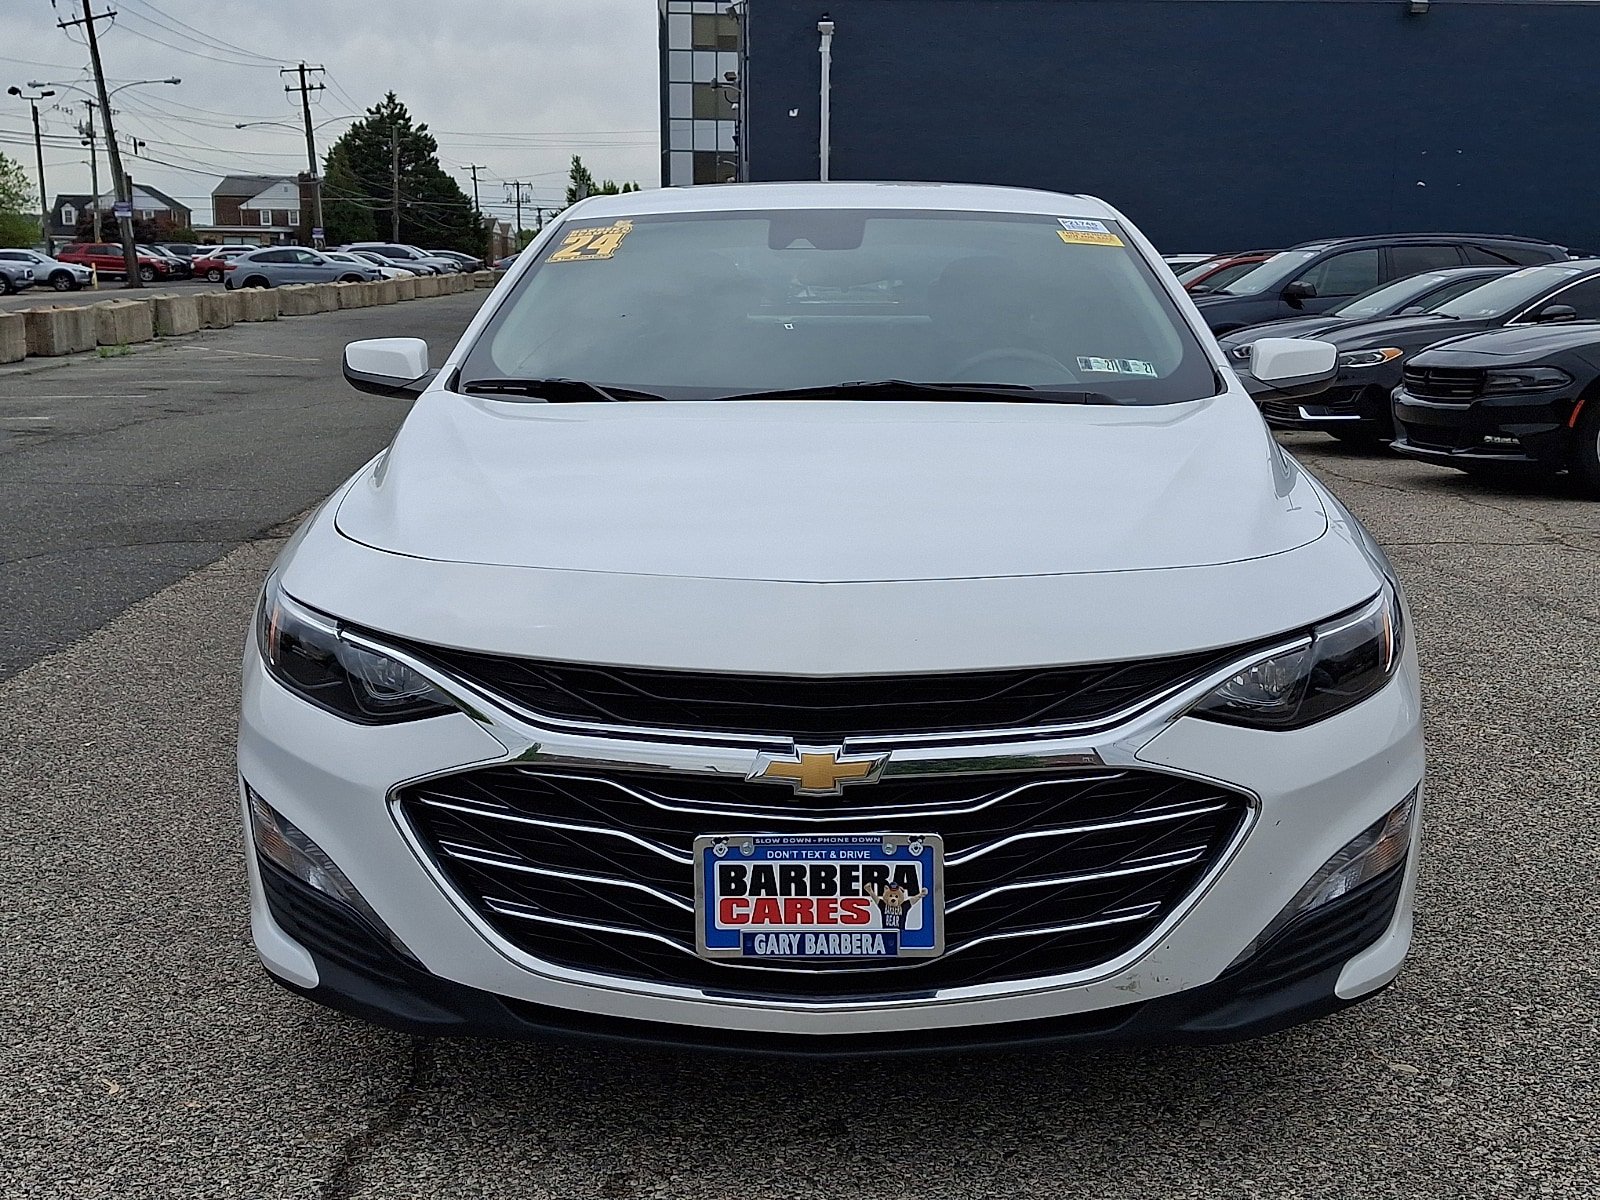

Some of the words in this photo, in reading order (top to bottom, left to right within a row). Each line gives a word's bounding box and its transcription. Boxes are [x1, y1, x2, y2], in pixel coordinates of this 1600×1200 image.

[551, 233, 623, 258] 24
[1142, 362, 1153, 374] 27
[767, 850, 798, 859] DON'T
[801, 850, 827, 859] TEXT
[829, 850, 837, 859] &
[840, 850, 871, 859] DRIVE
[718, 864, 920, 897] BARBERA
[719, 897, 871, 925] CARES
[754, 933, 801, 955] GARY
[804, 933, 886, 955] BARBERA
